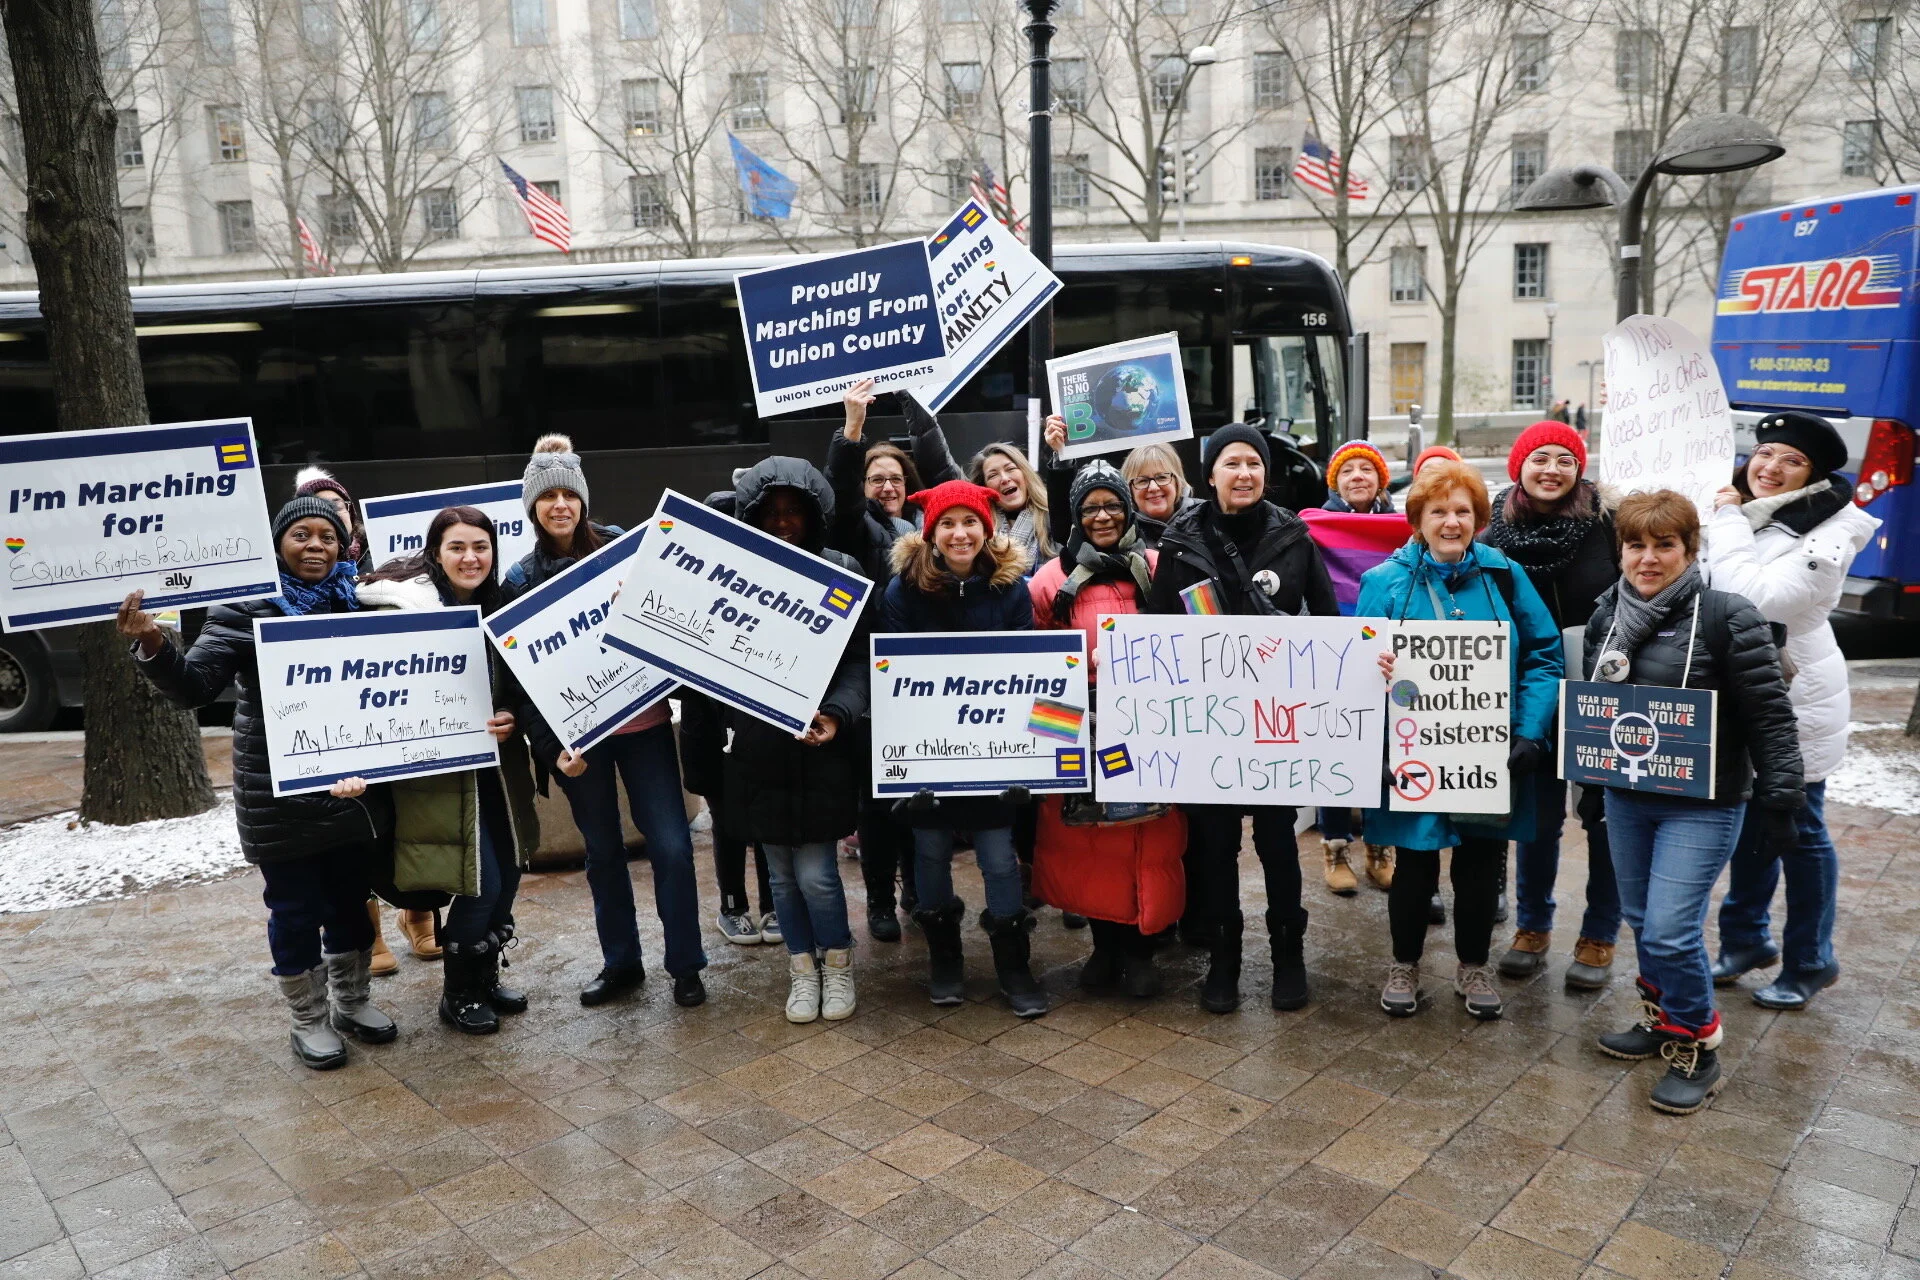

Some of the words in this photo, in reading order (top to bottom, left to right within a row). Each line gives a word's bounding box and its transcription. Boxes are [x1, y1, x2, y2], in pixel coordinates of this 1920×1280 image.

[1794, 219, 1819, 237] 197
[936, 235, 994, 299] rching
[791, 271, 882, 305] Proudly
[1740, 259, 1873, 311] STARR
[755, 306, 861, 342] Marching
[868, 293, 928, 319] From
[945, 270, 1012, 351] MANITY
[1301, 313, 1327, 326] 156
[769, 343, 835, 369] Union
[843, 323, 926, 353] County
[775, 388, 811, 403] UNION
[867, 366, 934, 384] EMOCRATS
[1062, 373, 1088, 385] THERE
[1063, 385, 1074, 396] IS
[1075, 382, 1089, 394] NO
[1648, 369, 1670, 400] de
[1064, 402, 1096, 440] B
[1653, 438, 1672, 475] de
[9, 488, 66, 513] I'm
[78, 471, 236, 507] Marching
[103, 513, 164, 538] for:
[389, 533, 423, 552] I'm
[165, 572, 192, 589] ally
[659, 541, 706, 575] I'm
[707, 563, 834, 635] Marching
[641, 589, 715, 641] Absolute
[708, 597, 761, 633] for:
[527, 630, 567, 664] I'm
[1392, 634, 1507, 660] PROTECT
[286, 663, 331, 686] I'm
[341, 652, 467, 681] Marching
[1109, 633, 1189, 685] HERE
[1201, 632, 1259, 683] FOR
[1256, 635, 1282, 664] ALL
[1288, 637, 1354, 690] MY
[1430, 663, 1474, 682] our
[360, 687, 409, 709] for:
[434, 690, 467, 705] Equality
[892, 677, 935, 697] I'm
[942, 674, 1067, 698] Marching
[271, 700, 307, 720] Women
[560, 687, 597, 713] My
[1408, 686, 1509, 711] mother
[1577, 694, 1599, 704] HEAR
[1602, 696, 1619, 706] OUR
[1648, 700, 1672, 711] HEAR
[1676, 703, 1695, 713] OUR
[958, 704, 1006, 724] for:
[1115, 694, 1246, 737] SISTERS
[1254, 696, 1306, 739] NOT
[1303, 701, 1375, 741] JUST
[1578, 704, 1619, 719] VOICE
[1649, 710, 1695, 727] VOICE
[292, 729, 321, 756] My
[365, 722, 382, 748] My
[420, 718, 435, 738] My
[439, 717, 472, 732] Future
[1420, 722, 1509, 745] sisters
[1616, 724, 1636, 734] HEAR
[1638, 726, 1653, 735] OUR
[1616, 733, 1653, 746] VOICE
[987, 737, 1036, 758] future!
[1576, 745, 1598, 755] HEAR
[1601, 748, 1618, 757] OUR
[297, 763, 323, 776] Love
[1577, 754, 1618, 771] VOICE
[1648, 754, 1671, 764] HEAR
[1675, 756, 1694, 766] OUR
[1648, 762, 1694, 780] VOICE
[886, 765, 908, 780] ally
[1137, 750, 1181, 788] MY
[1210, 755, 1354, 796] CISTERS
[1438, 765, 1497, 790] kids
